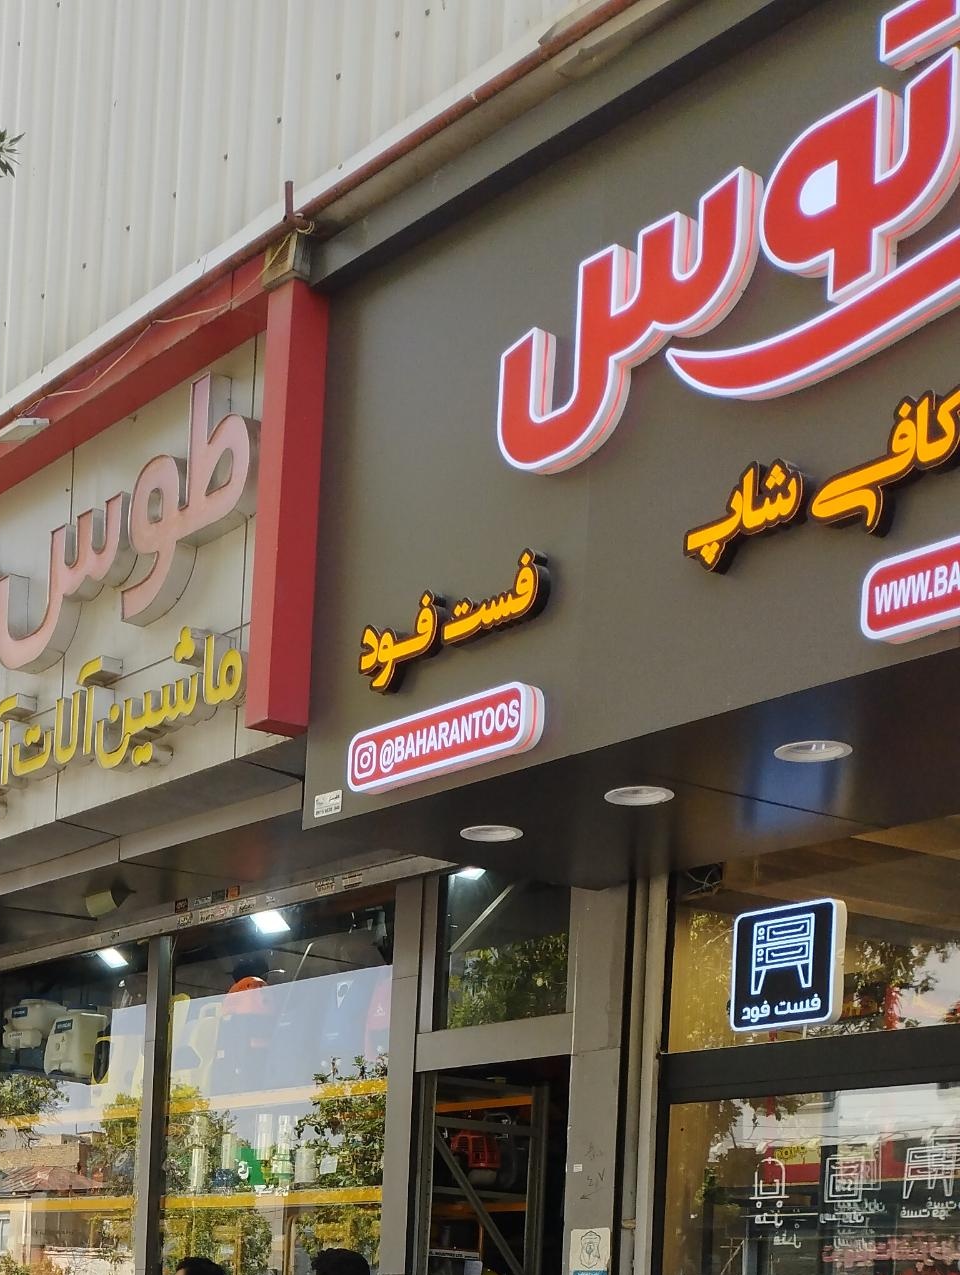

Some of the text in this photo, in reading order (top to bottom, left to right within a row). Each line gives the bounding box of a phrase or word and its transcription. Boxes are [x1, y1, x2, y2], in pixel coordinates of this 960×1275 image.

[685, 462, 800, 566] شاپ
[358, 550, 537, 690] فست فود
[10, 656, 102, 777] آلات
[95, 626, 246, 770] ماشین
[380, 699, 521, 774] @BAHARANTOOS
[741, 993, 822, 1023] فست فود
